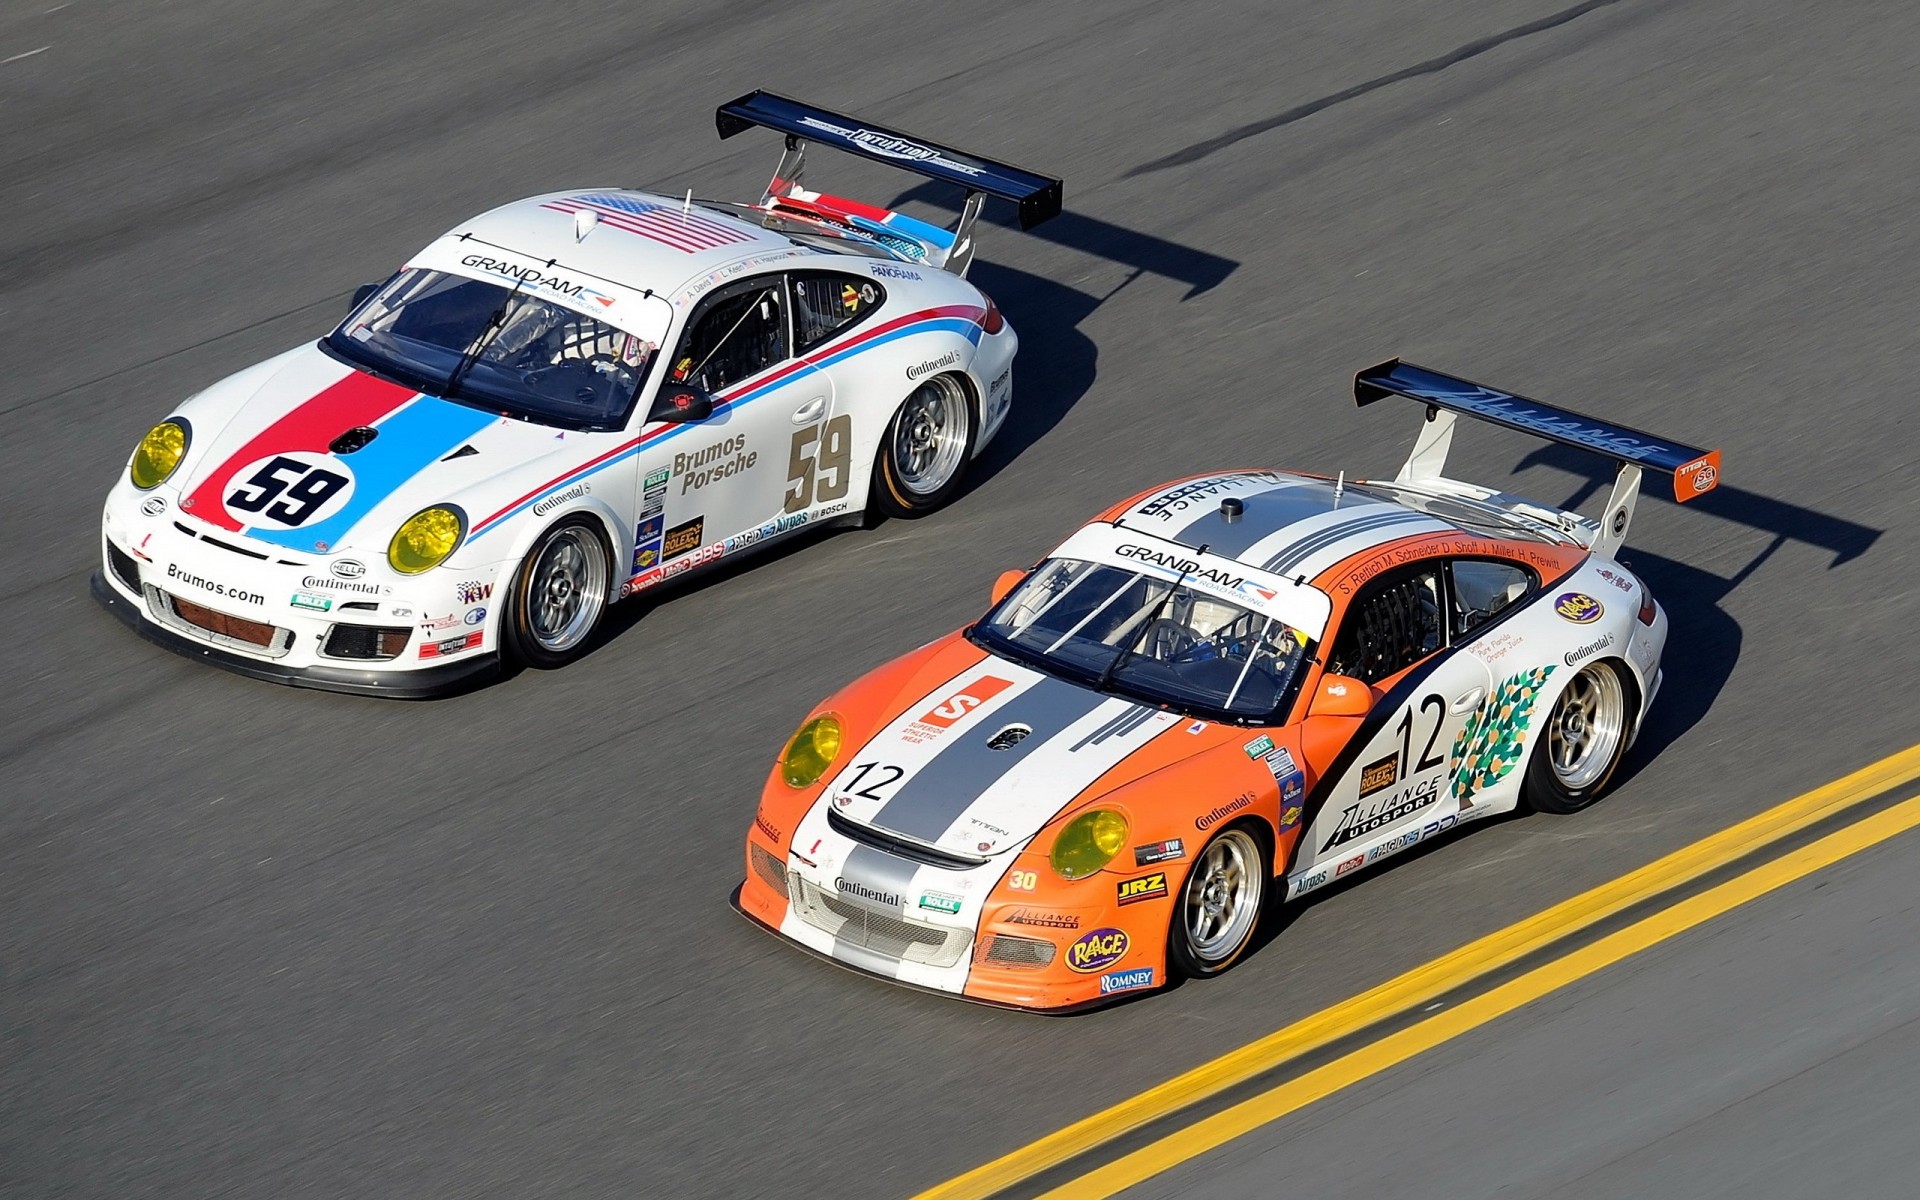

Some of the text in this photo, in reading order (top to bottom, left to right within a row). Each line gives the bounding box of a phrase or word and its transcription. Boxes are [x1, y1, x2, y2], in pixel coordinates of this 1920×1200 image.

[855, 130, 933, 160] INTUITION
[871, 265, 923, 281] PANORAMA
[906, 351, 956, 380] Continental
[672, 433, 746, 478] Brumos
[784, 414, 852, 514] 59
[681, 451, 758, 496] Porsche
[226, 456, 350, 527] 59
[533, 484, 584, 517] Continental
[775, 512, 808, 534] Airgas
[821, 502, 848, 517] BOSCH
[664, 532, 691, 552] ROLEX
[693, 541, 725, 565] BBS
[1339, 583, 1354, 595] S.
[1350, 560, 1384, 588] Rettich
[1384, 556, 1397, 568] M.
[1396, 544, 1440, 563] Schneider
[1455, 541, 1479, 554] Shoff
[1492, 544, 1515, 558] Miller
[1530, 551, 1561, 571] Prewitt
[167, 563, 265, 606] Brumos.com
[302, 575, 380, 594] Continental
[464, 582, 495, 604] KW
[1199, 580, 1267, 609] ROAD RACING
[1564, 635, 1610, 668] Continental
[1396, 693, 1446, 781] 12
[842, 761, 904, 801] 12
[1361, 768, 1388, 790] ROLEX
[1195, 793, 1251, 831] Continental
[1320, 774, 1443, 850] ALLIANCE
[1379, 835, 1405, 860] PAGID
[834, 876, 899, 907] Continental
[1009, 870, 1038, 890] 30
[1119, 873, 1165, 897] JRZ
[1295, 871, 1327, 895] Airgas
[1101, 971, 1152, 993] ROMNEY
